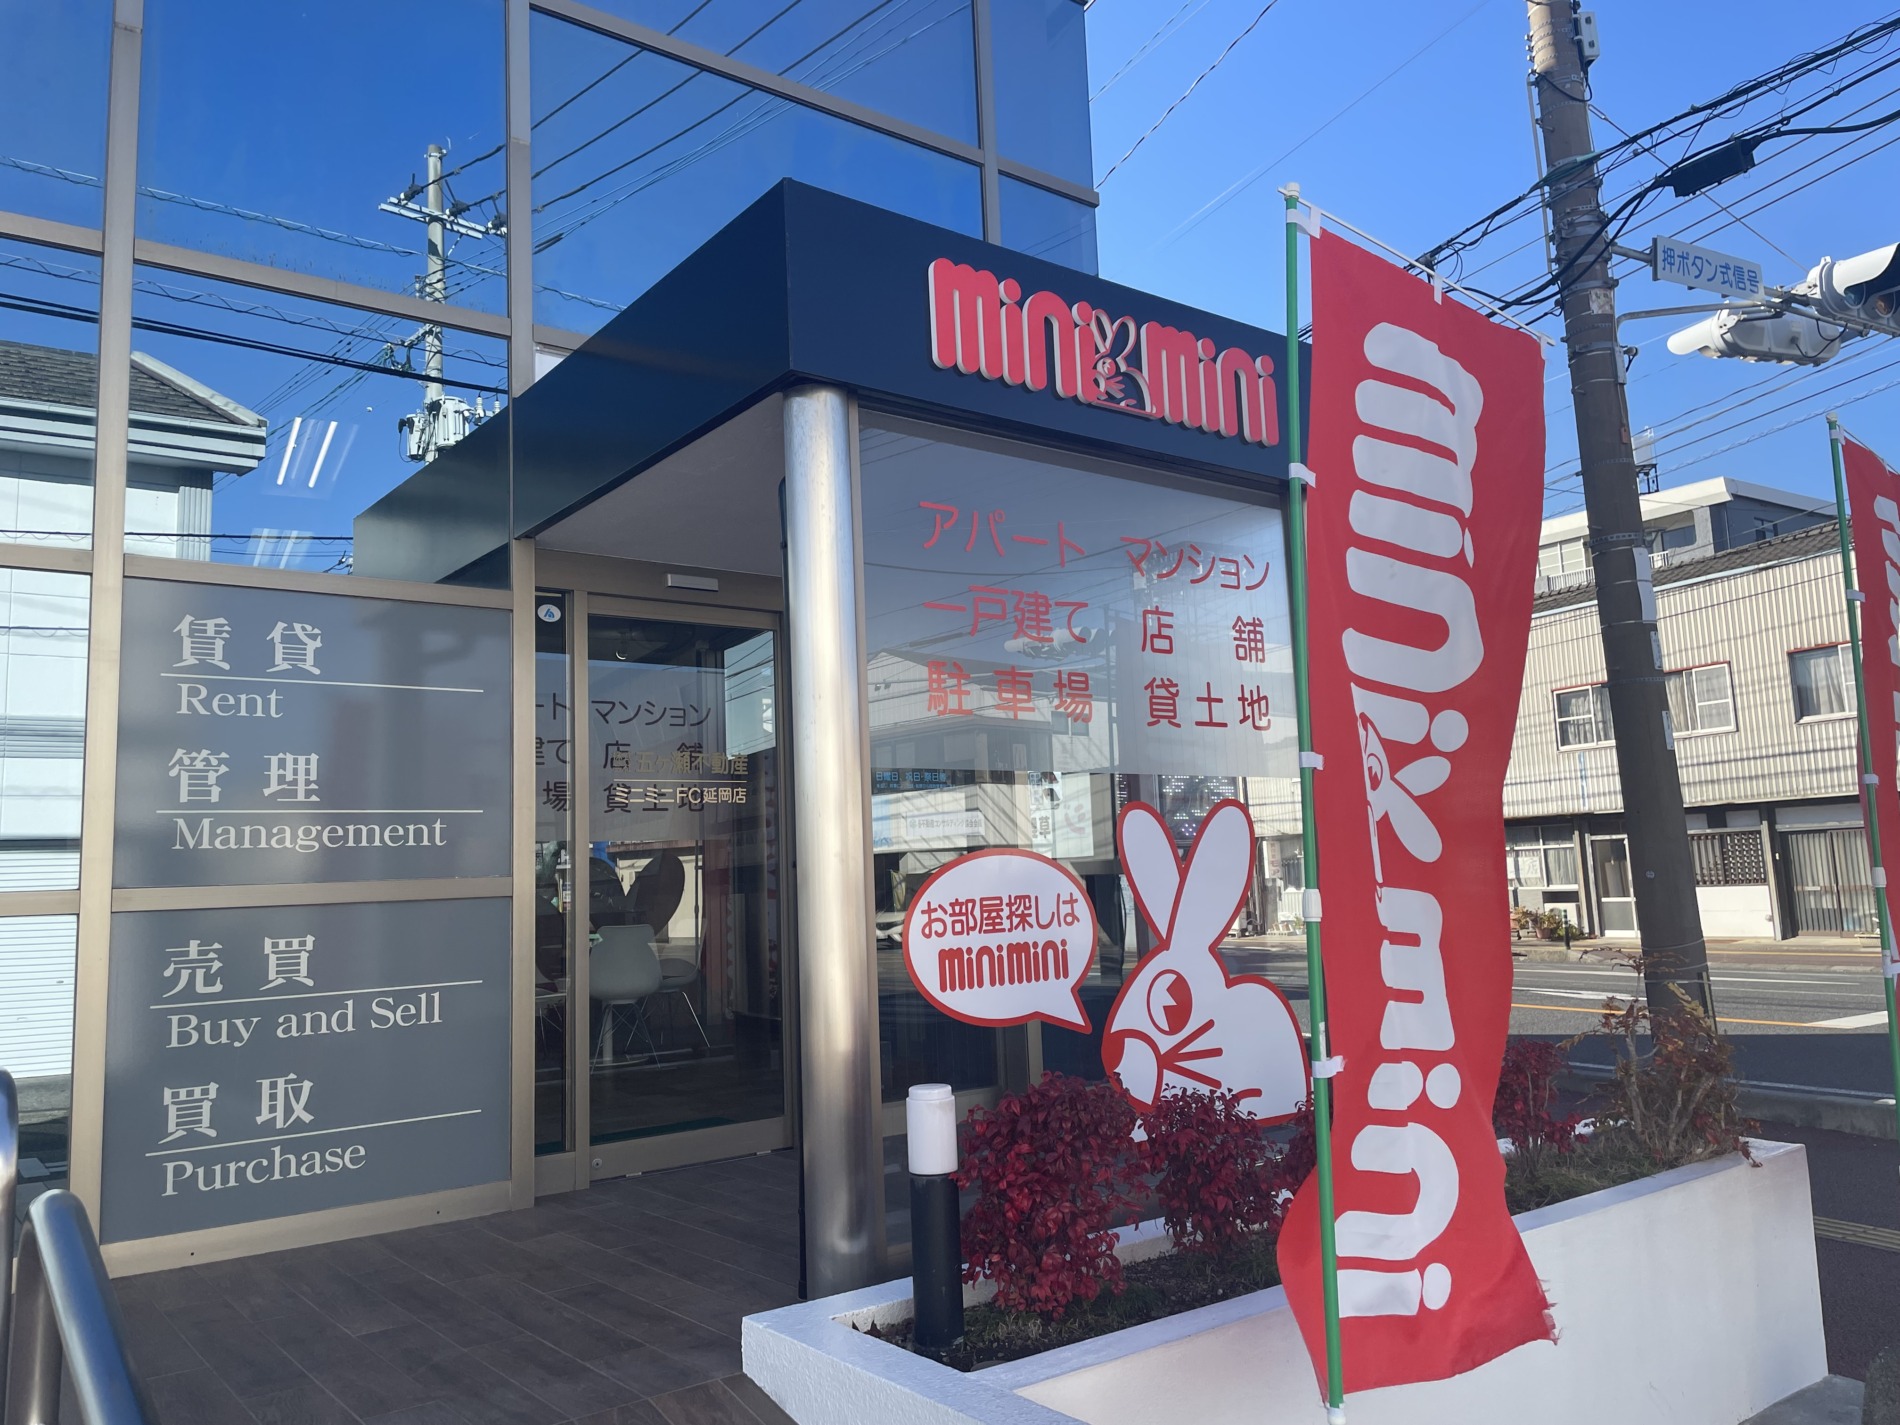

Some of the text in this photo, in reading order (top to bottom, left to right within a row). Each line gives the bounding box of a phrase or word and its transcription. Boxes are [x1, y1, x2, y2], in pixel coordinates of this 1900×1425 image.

[1661, 245, 1760, 295] 押ボタン式信号
[918, 501, 1271, 592] アパート マンション
[923, 584, 1089, 644] 一戸建て
[171, 613, 323, 676] 賃貸
[175, 683, 284, 719] Rent
[591, 700, 712, 727] マンション
[927, 660, 1272, 732] 駐車場 貸土地
[168, 747, 321, 804] 管理
[171, 817, 447, 853] Management
[920, 892, 1080, 939] お部屋探しは
[162, 934, 316, 998] 売買
[165, 991, 443, 1048] Buy and Sell
[158, 1072, 315, 1145] 買取
[161, 1144, 367, 1197] Purchase
